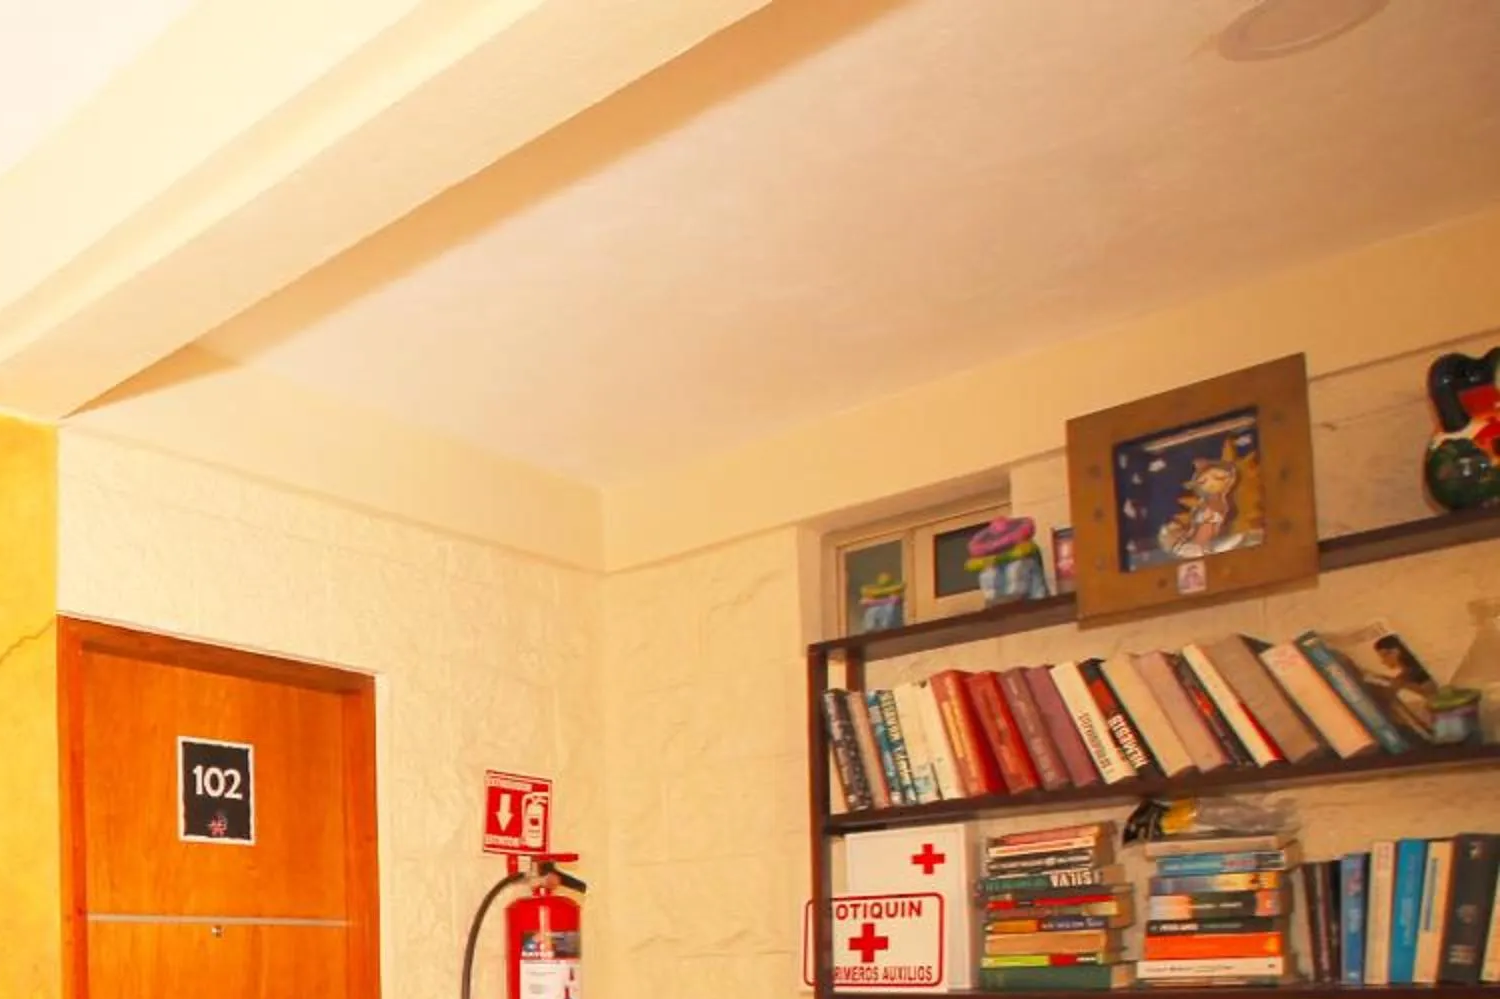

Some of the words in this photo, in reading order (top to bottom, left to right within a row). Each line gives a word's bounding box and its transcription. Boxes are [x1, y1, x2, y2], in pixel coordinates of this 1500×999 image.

[192, 764, 243, 800] 102
[835, 900, 923, 920] OTIQUIN
[834, 965, 879, 981] RIMEROS
[882, 965, 934, 981] AUXILIOS
